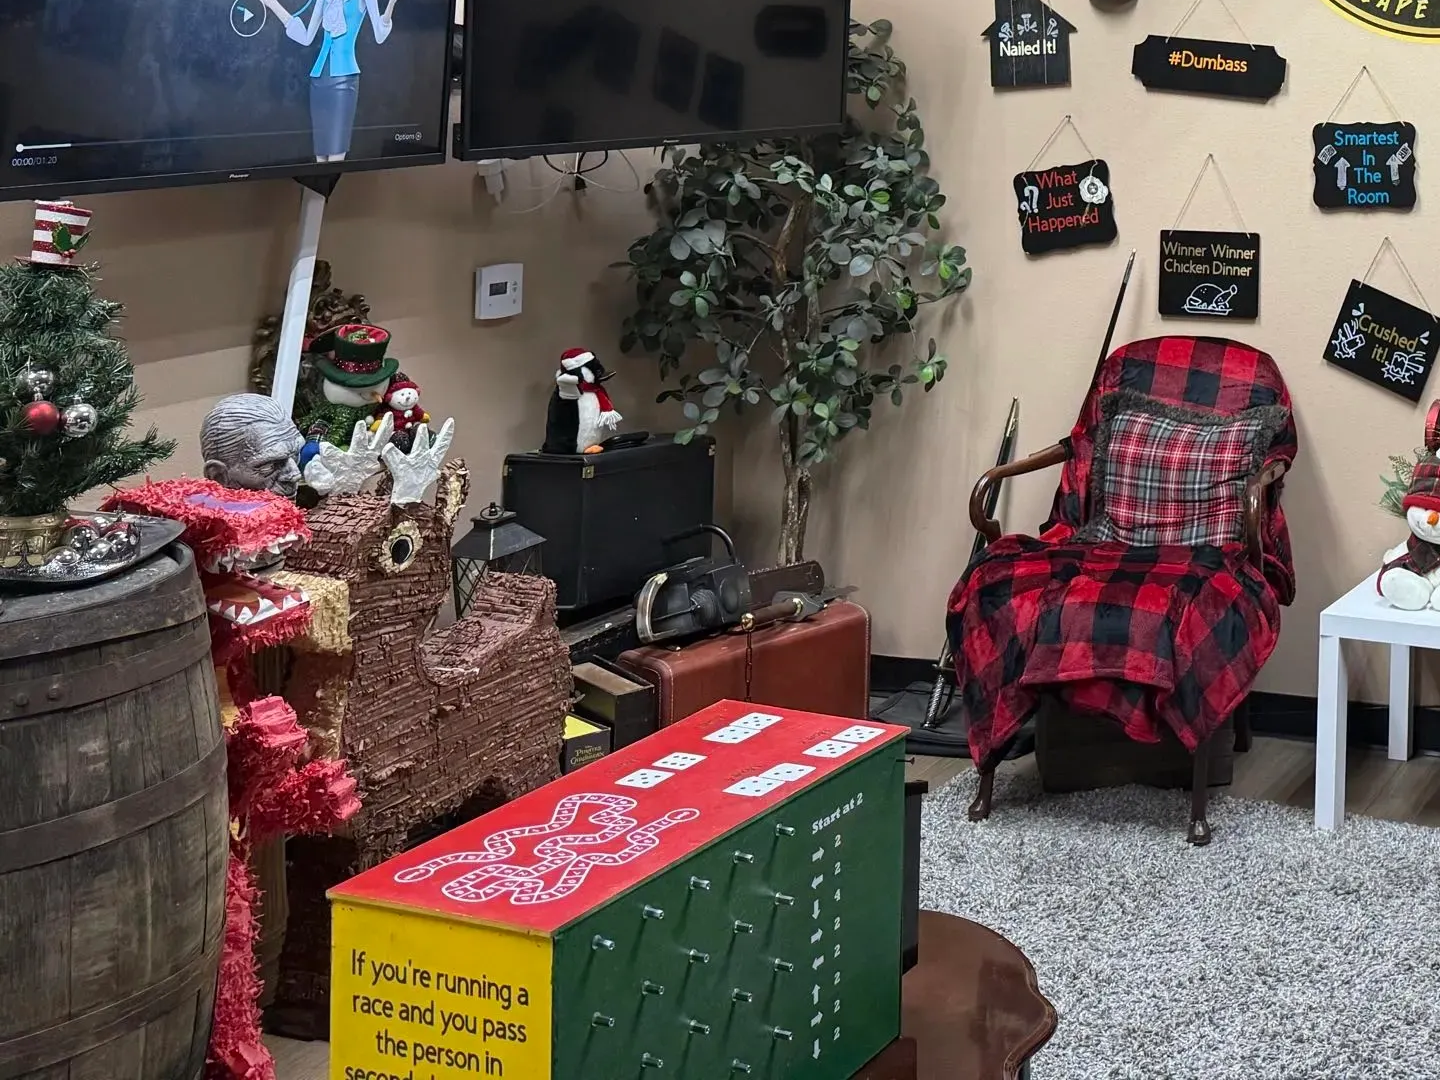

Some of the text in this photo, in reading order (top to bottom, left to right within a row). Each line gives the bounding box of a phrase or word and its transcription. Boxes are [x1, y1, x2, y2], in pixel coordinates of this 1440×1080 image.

[1000, 40, 1056, 57] Nailed It!
[1168, 50, 1248, 73] #Dumbass
[1334, 130, 1399, 146] Smartest
[1362, 149, 1376, 166] In
[1035, 170, 1078, 190] What
[1353, 167, 1382, 184] The
[1045, 192, 1075, 210] Just
[1347, 187, 1390, 205] Room
[1028, 207, 1100, 234] Happened
[1162, 240, 1256, 260] Winner Winner
[1163, 258, 1253, 277] Chicken Dinner
[1359, 314, 1419, 353] Crushed
[1371, 343, 1388, 363] it!
[812, 792, 864, 835] Start at 2
[834, 834, 842, 849] 2
[834, 861, 841, 876] 2
[833, 916, 841, 931] 2
[833, 944, 841, 958] 2
[351, 948, 529, 1011] If you're running a
[833, 971, 841, 986] 2
[833, 999, 841, 1014] 2
[352, 993, 528, 1043] race and you pass
[833, 1026, 841, 1041] 2
[376, 1028, 503, 1077] the person in
